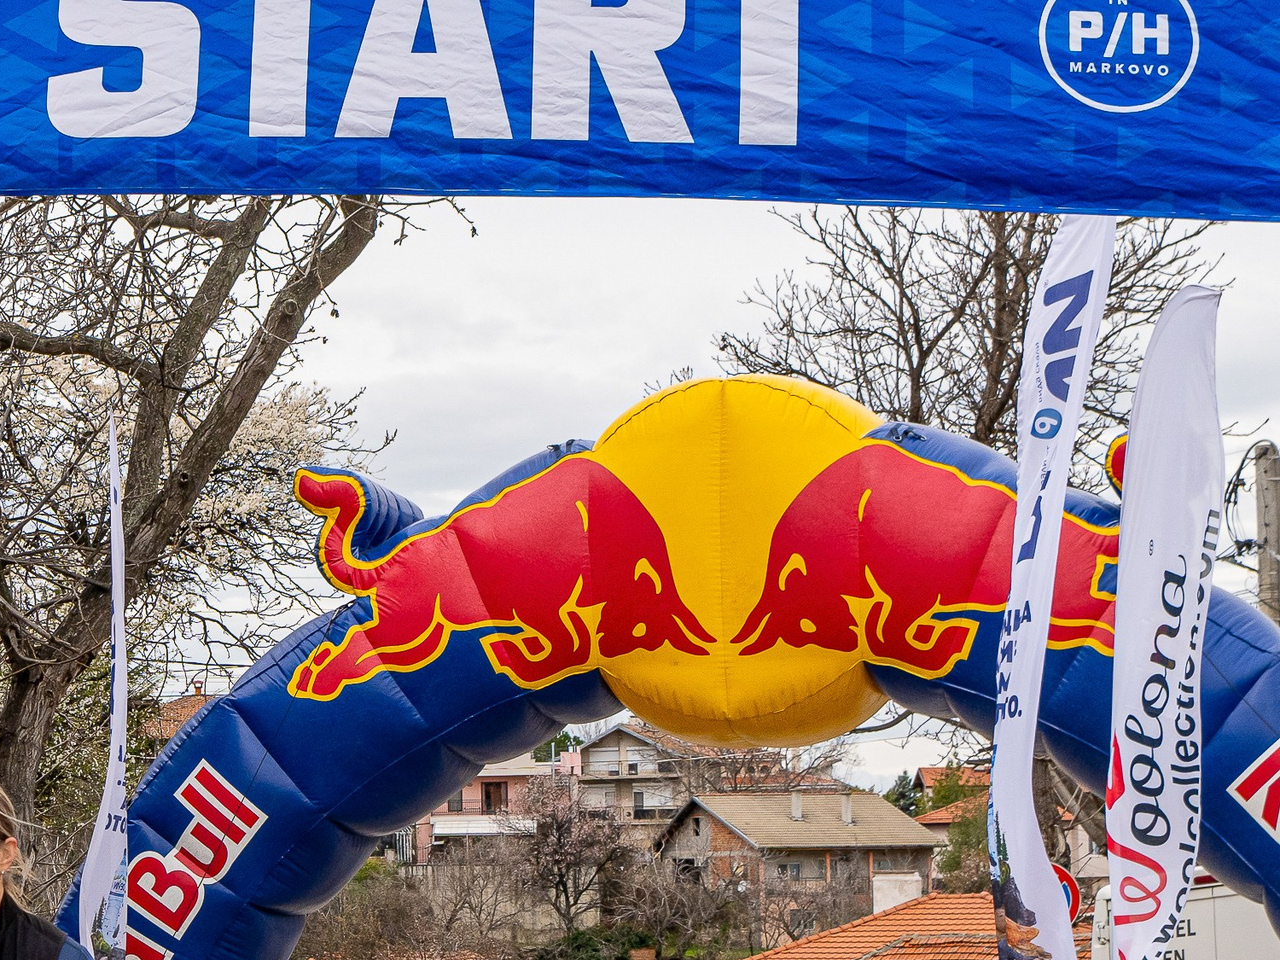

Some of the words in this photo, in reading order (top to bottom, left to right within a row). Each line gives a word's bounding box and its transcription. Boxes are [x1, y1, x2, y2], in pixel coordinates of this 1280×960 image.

[1068, 10, 1170, 58] P/H
[1069, 61, 1170, 77] MARKOVO
[126, 759, 267, 938] Bull
